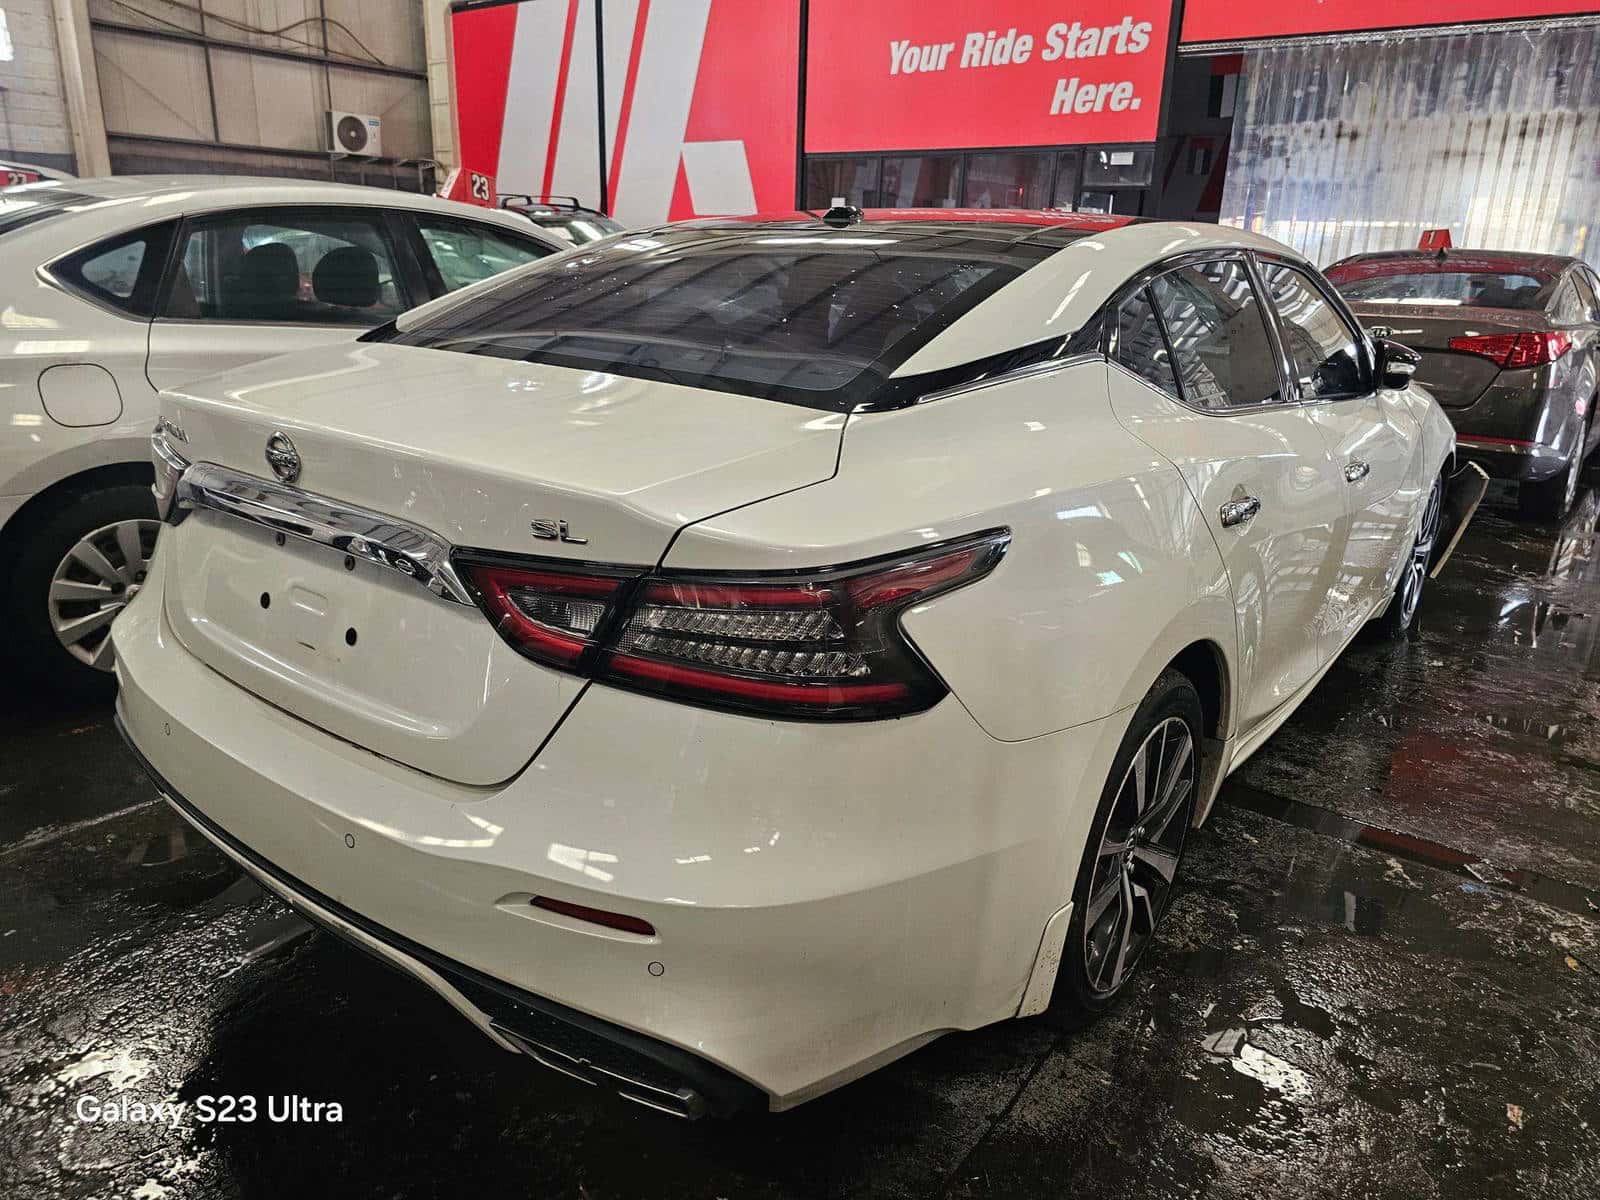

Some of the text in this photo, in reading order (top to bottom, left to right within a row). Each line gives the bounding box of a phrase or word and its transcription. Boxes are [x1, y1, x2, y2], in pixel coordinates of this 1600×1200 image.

[889, 16, 1153, 75] Your Ride Starts
[1049, 78, 1142, 115] Here.
[471, 173, 490, 201] 23
[530, 519, 588, 545] SL
